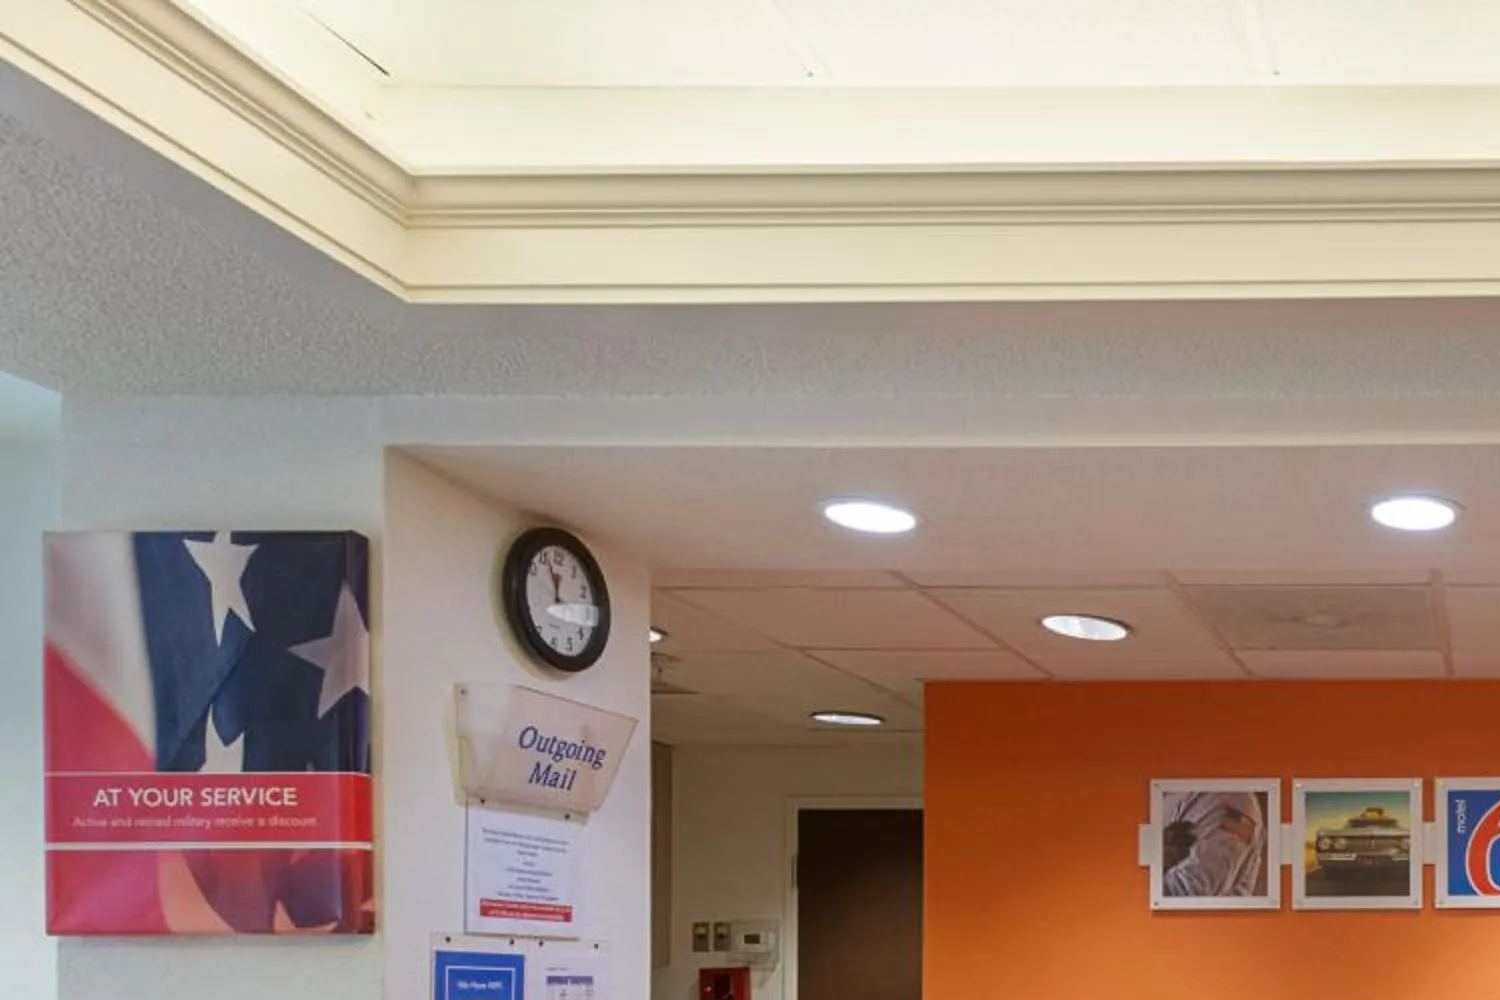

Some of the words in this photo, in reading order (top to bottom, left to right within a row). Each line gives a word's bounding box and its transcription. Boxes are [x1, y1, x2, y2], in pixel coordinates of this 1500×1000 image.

[518, 725, 607, 771] Outgoing
[527, 760, 577, 791] Mail
[92, 787, 123, 807] AT
[128, 787, 194, 808] YOUR
[200, 787, 299, 807] SERVICE
[73, 816, 107, 828] Active
[110, 816, 133, 827] and
[1455, 799, 1467, 834] motel
